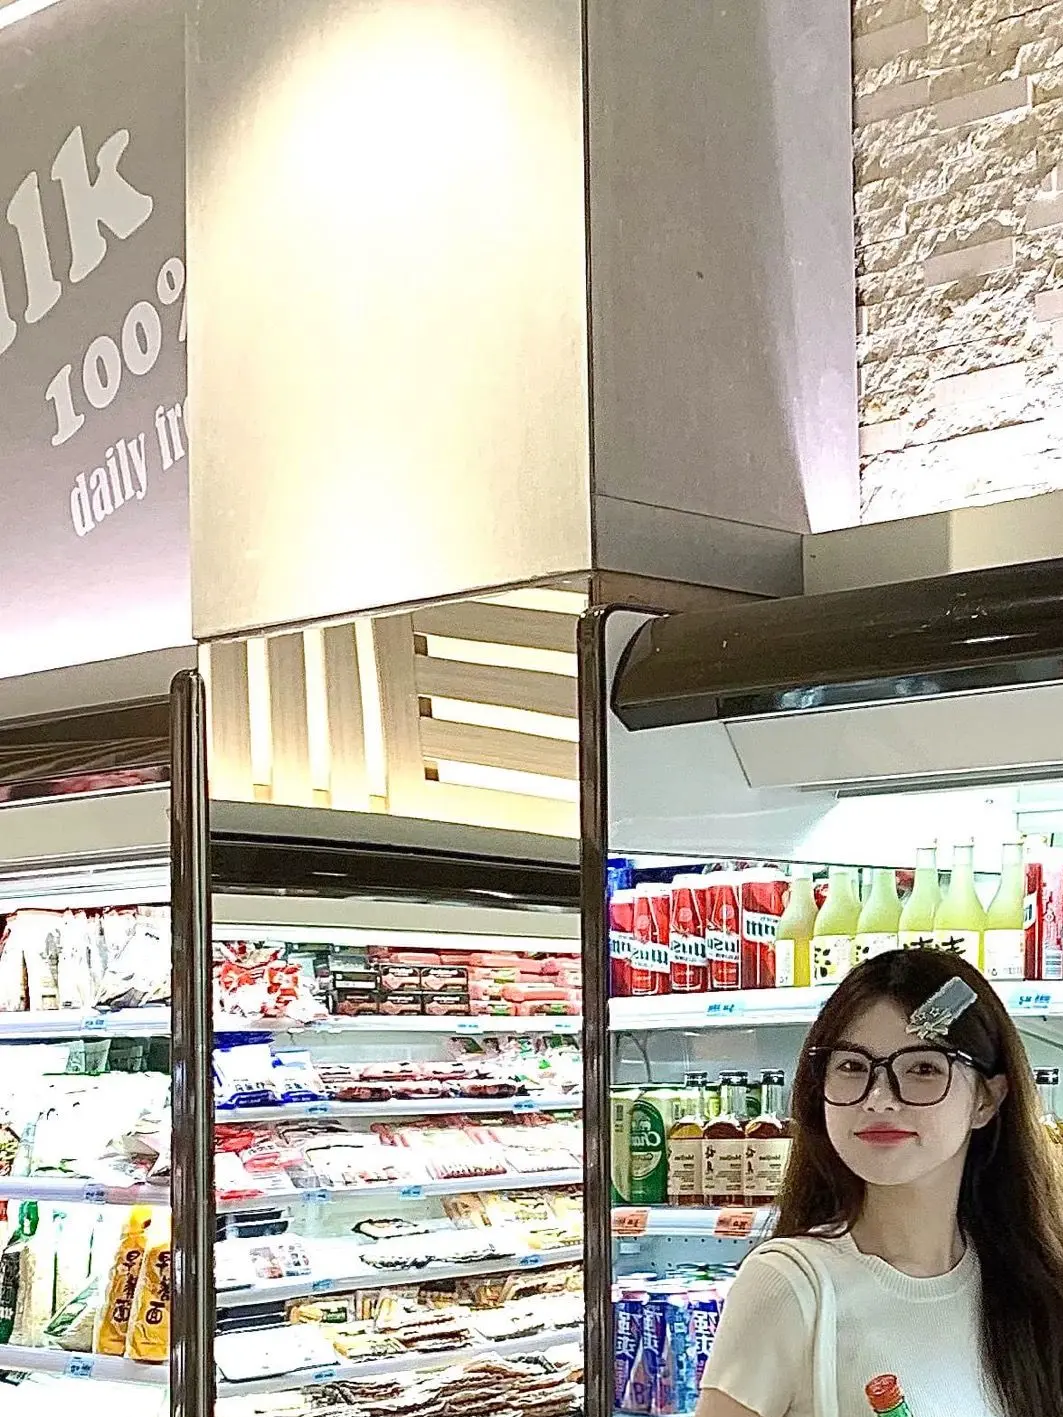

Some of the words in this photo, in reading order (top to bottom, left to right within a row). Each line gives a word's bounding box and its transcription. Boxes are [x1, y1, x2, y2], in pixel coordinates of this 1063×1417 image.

[0, 126, 153, 355] lk
[70, 432, 146, 537] daily
[155, 402, 188, 472] fr
